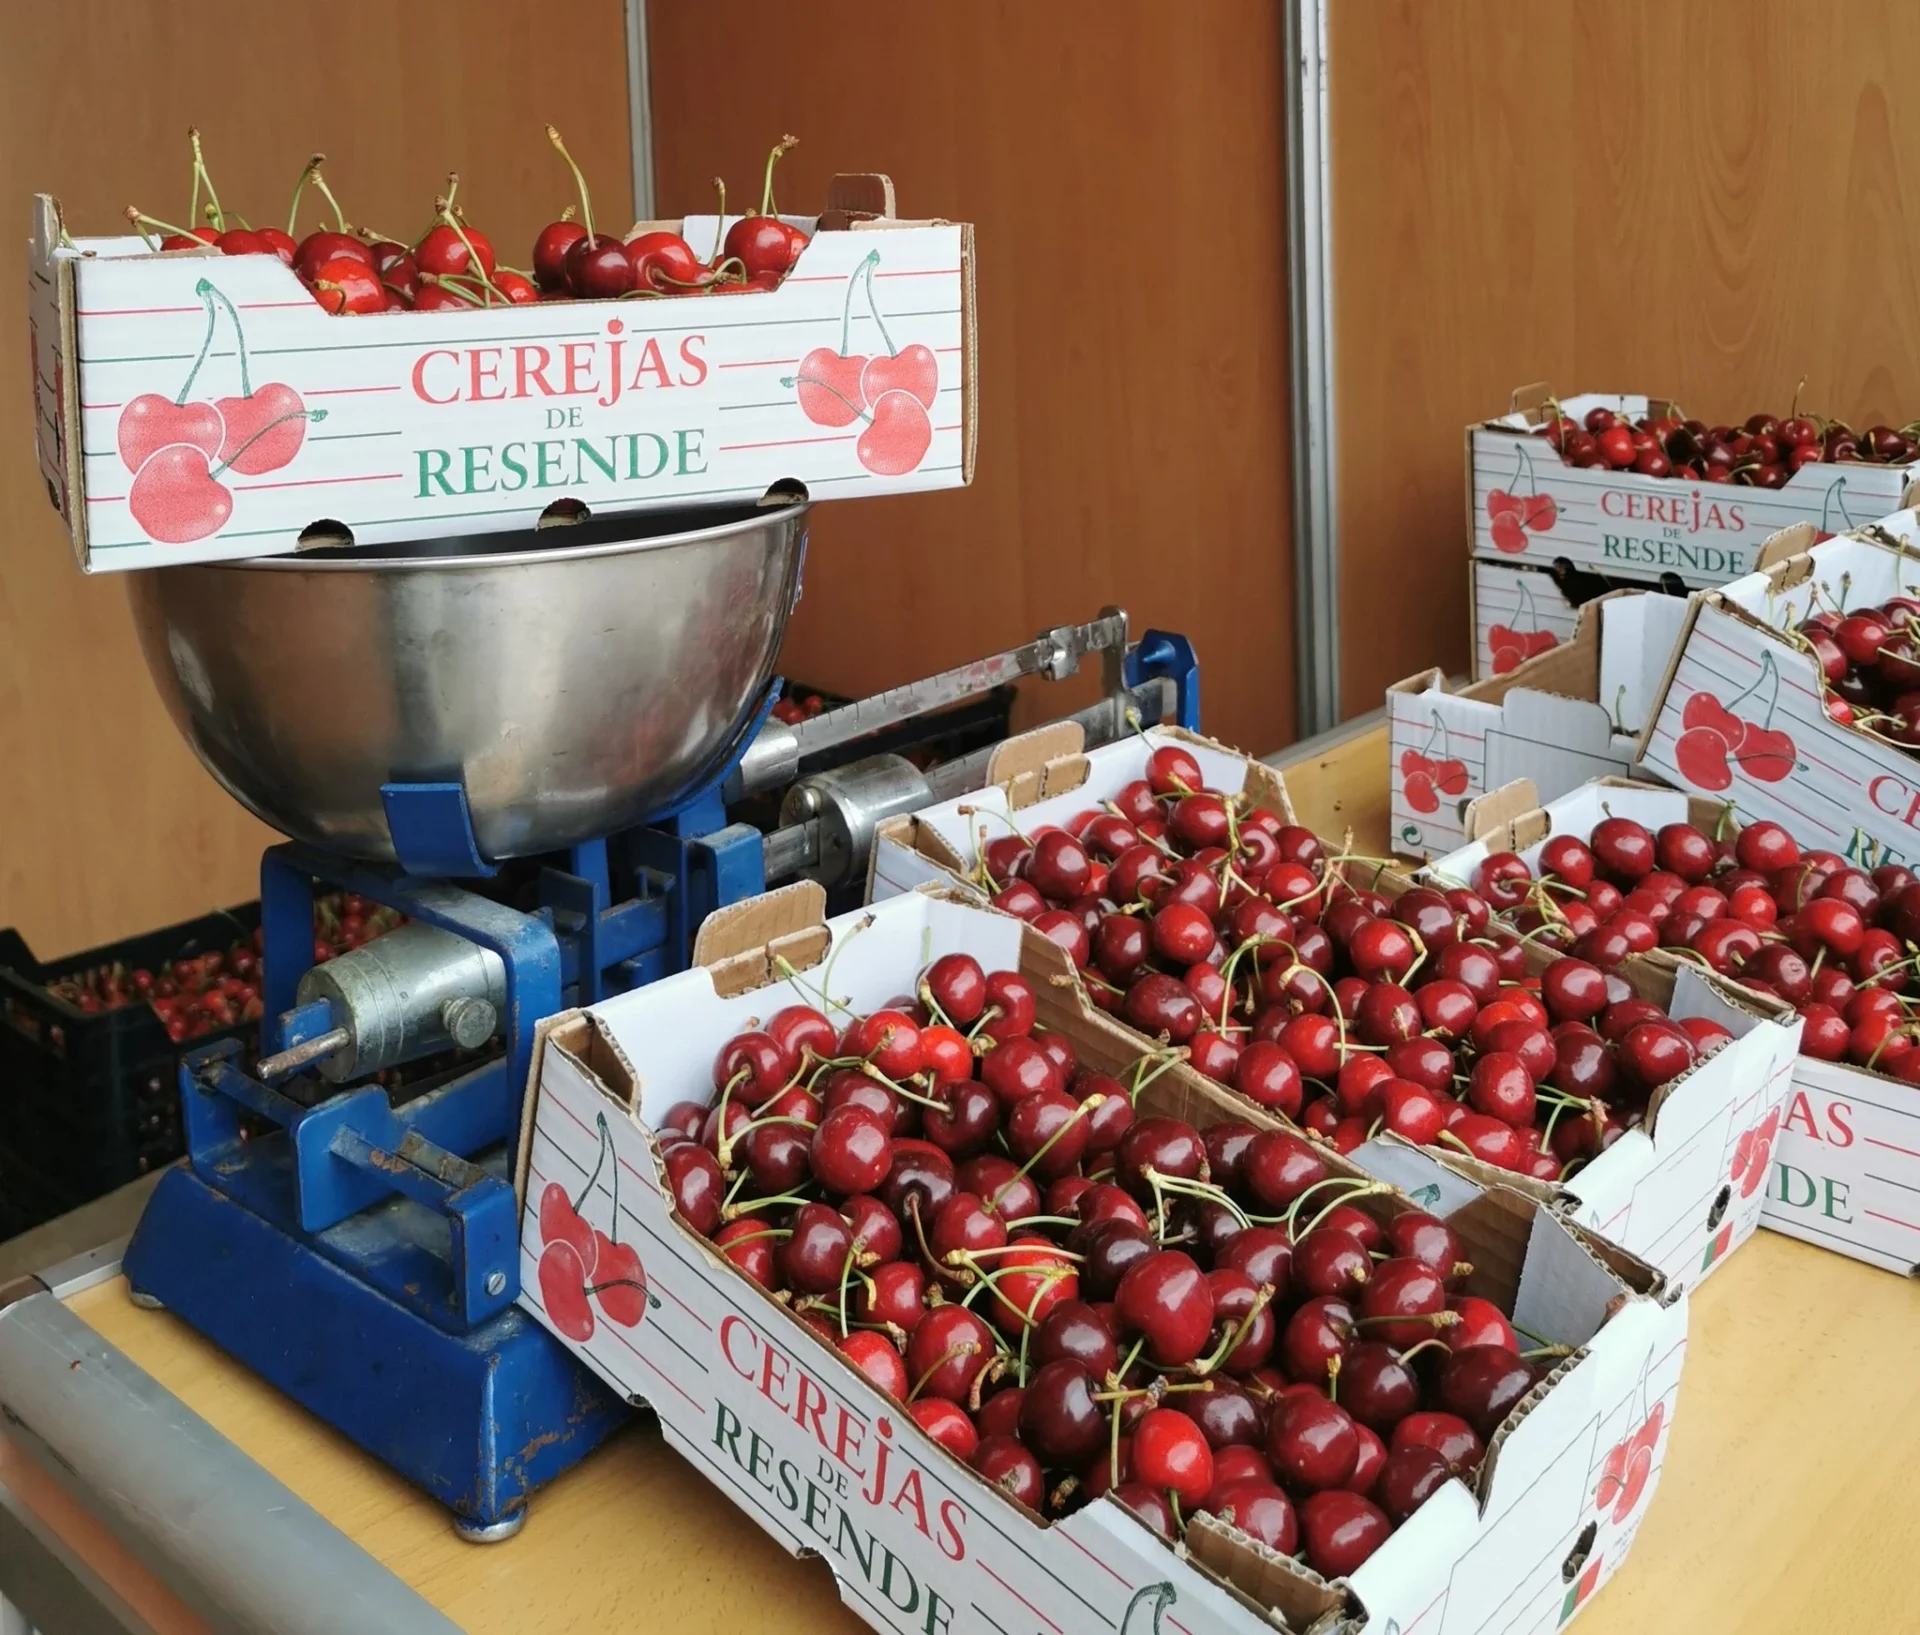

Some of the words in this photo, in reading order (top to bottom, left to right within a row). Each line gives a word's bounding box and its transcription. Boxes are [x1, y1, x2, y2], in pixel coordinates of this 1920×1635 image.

[544, 406, 584, 430] DE
[413, 428, 708, 498] RESENDE
[1601, 533, 1747, 576] RESENDE
[1662, 526, 1683, 540] DE
[1765, 1161, 1854, 1225] DE
[816, 1454, 849, 1500] DE
